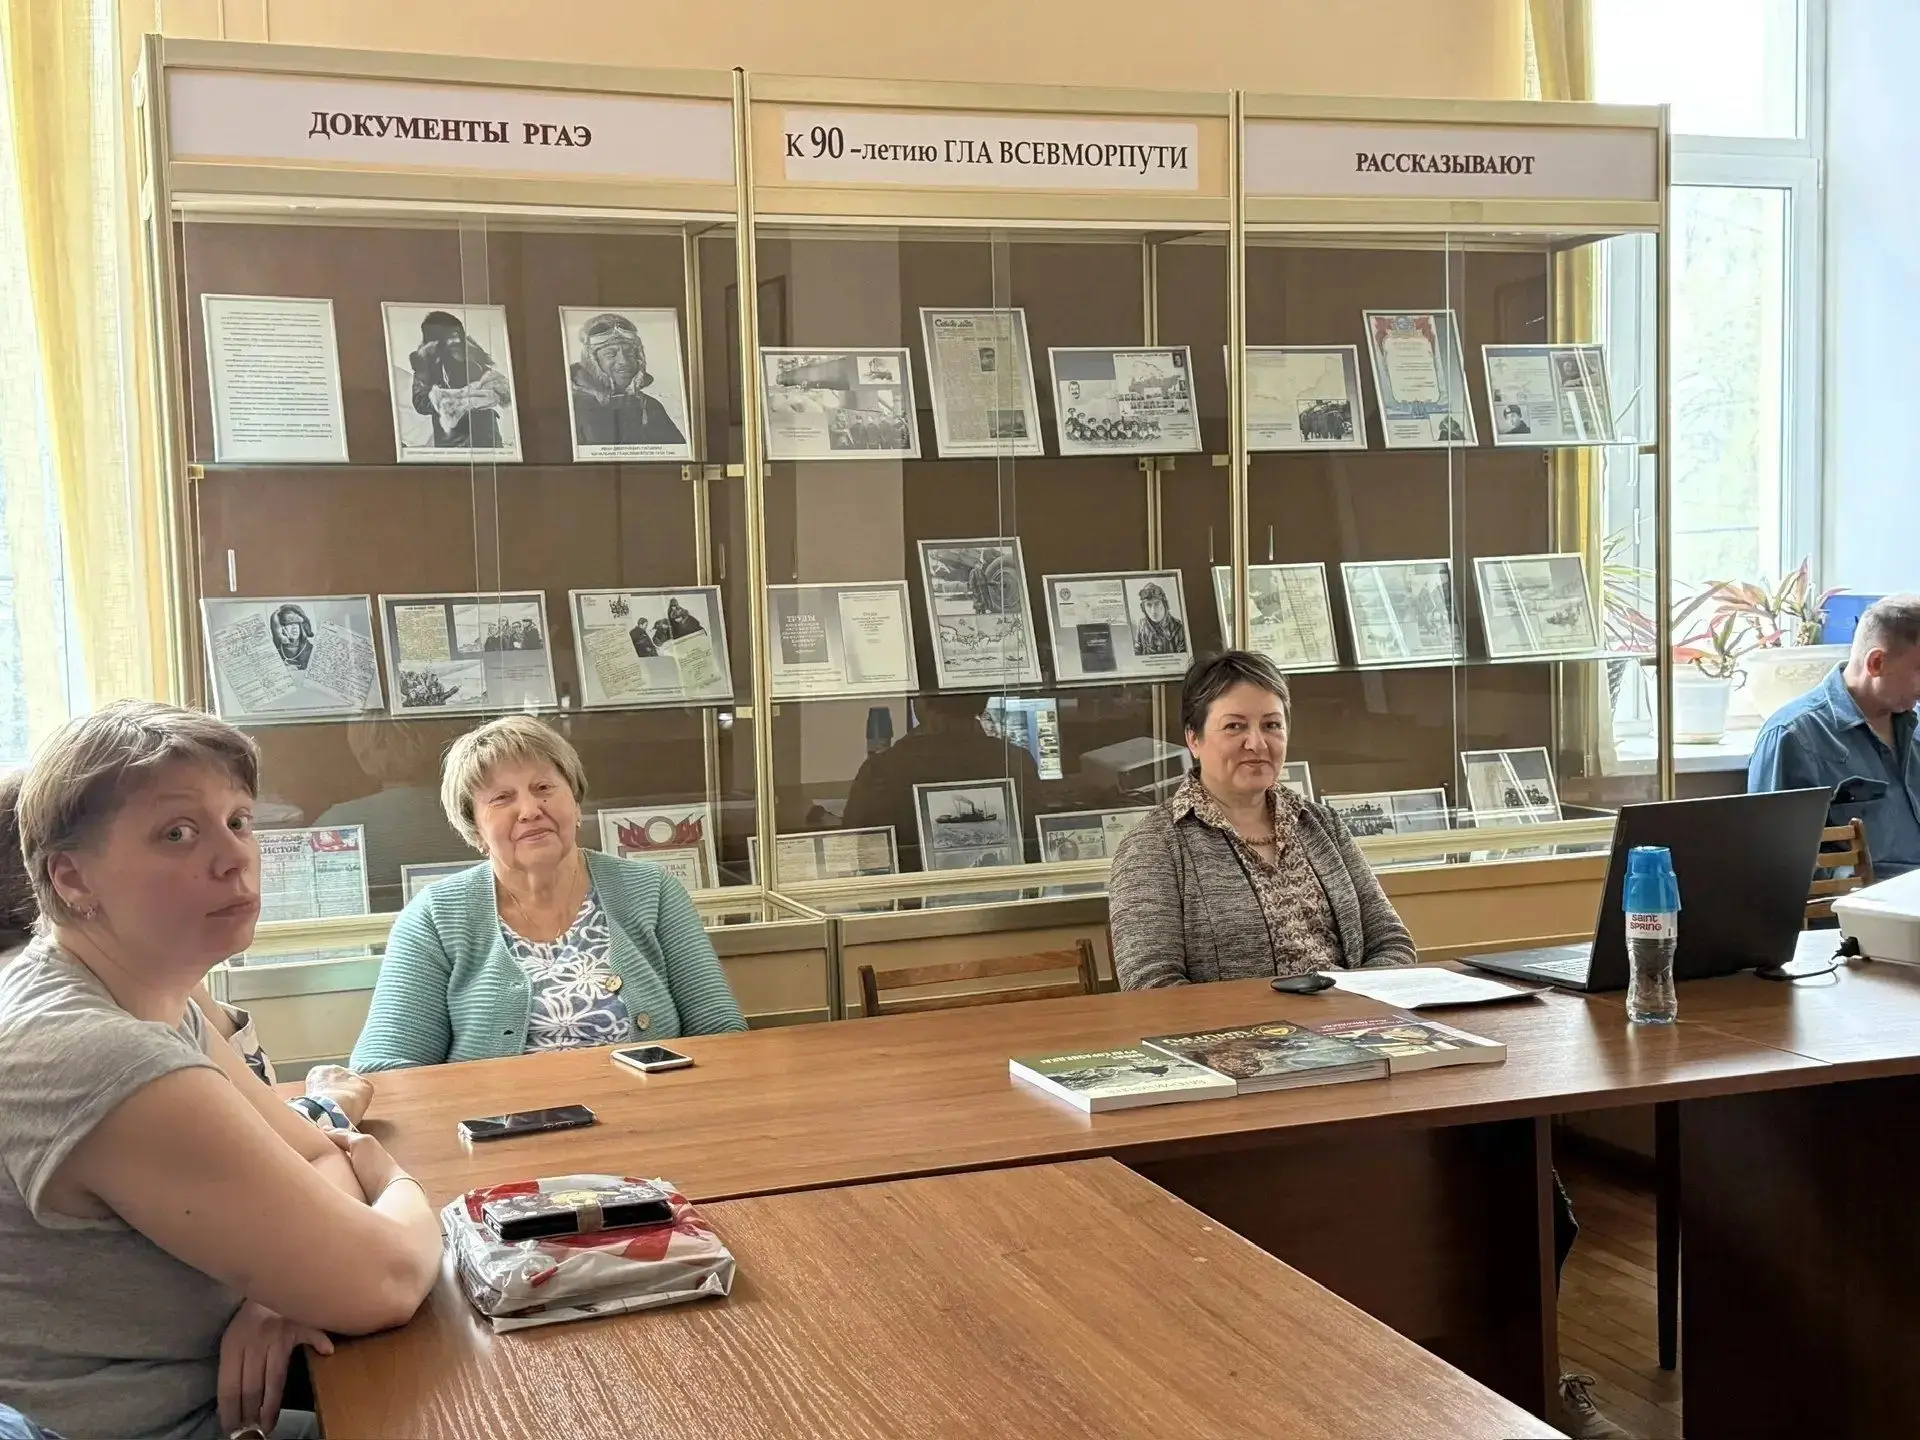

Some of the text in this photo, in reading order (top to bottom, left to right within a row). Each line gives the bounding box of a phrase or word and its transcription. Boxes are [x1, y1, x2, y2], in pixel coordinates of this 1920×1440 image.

[309, 111, 592, 147] ДОКУМЕНТЫ РГАЭ
[786, 133, 804, 157] К
[811, 126, 844, 159] 90
[1356, 153, 1535, 175] РАССКАЗЫВАЮТ
